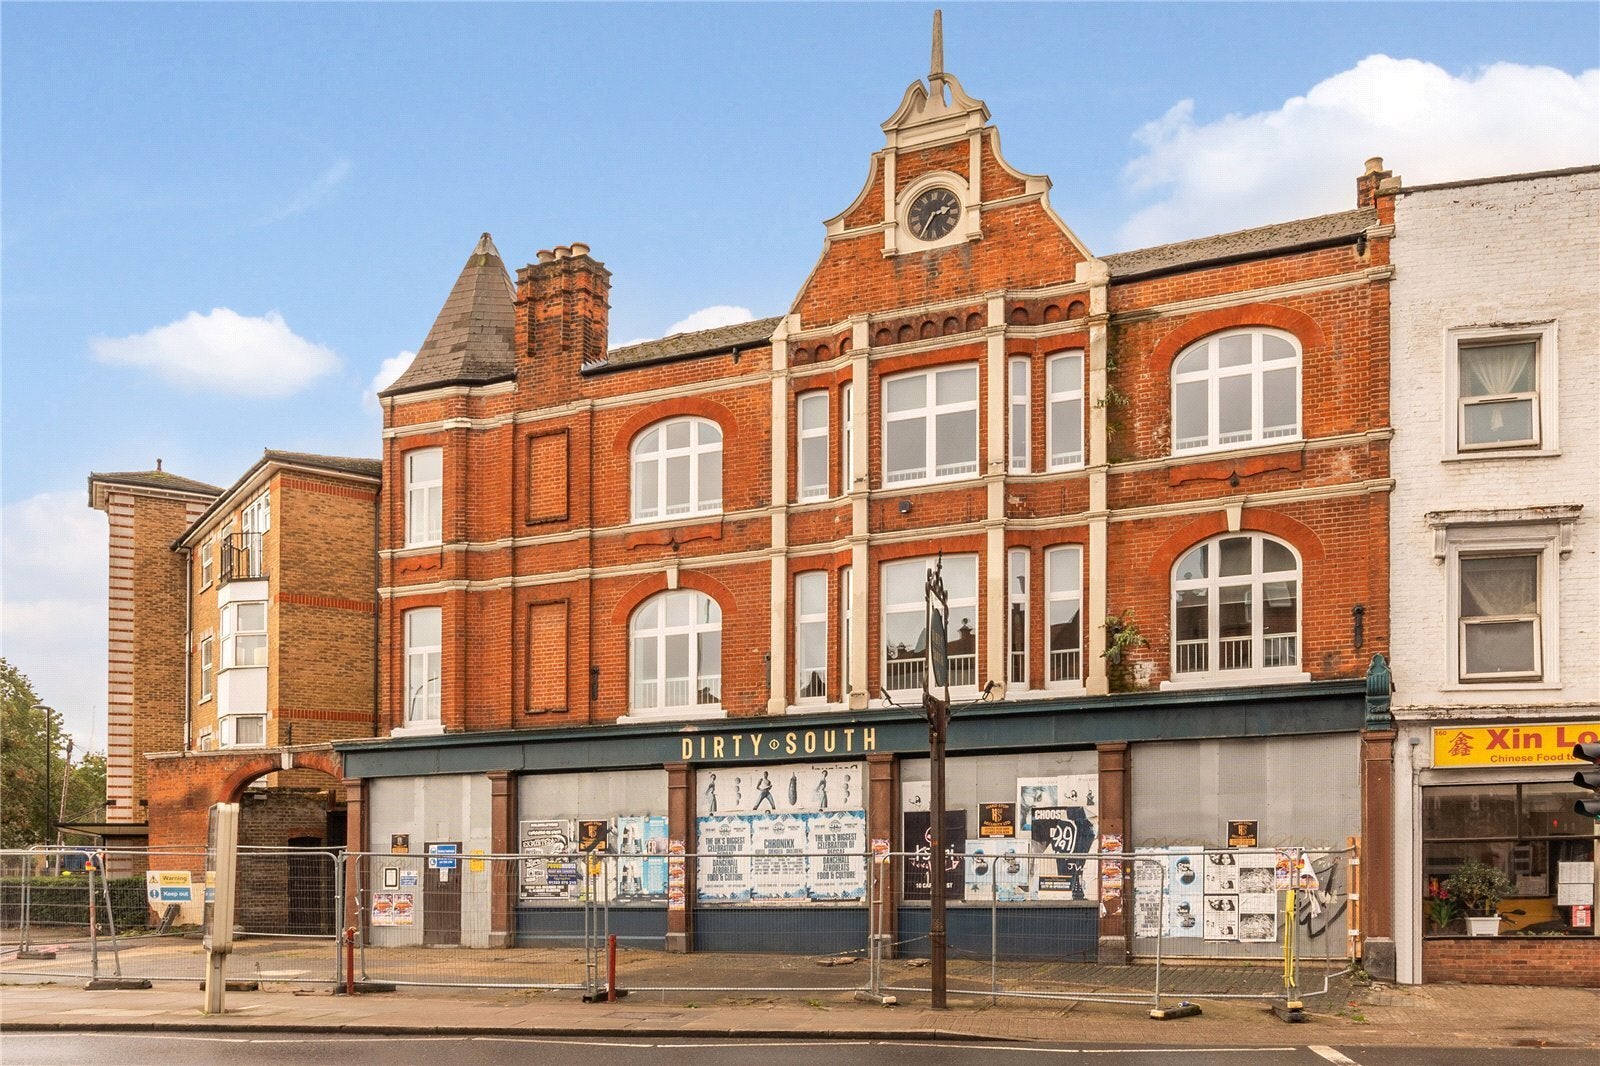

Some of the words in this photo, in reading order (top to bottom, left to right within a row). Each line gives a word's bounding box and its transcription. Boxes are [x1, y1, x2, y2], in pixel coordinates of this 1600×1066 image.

[682, 734, 762, 760] DIRTY
[785, 727, 876, 755] SOUTH
[1448, 731, 1474, 757] 鑫
[1486, 728, 1542, 750] Xin
[1490, 754, 1533, 763] Chinese
[1536, 753, 1564, 762] Food
[815, 834, 823, 842] THE
[837, 833, 857, 841] BIGGEST
[836, 871, 856, 879] CULTURE
